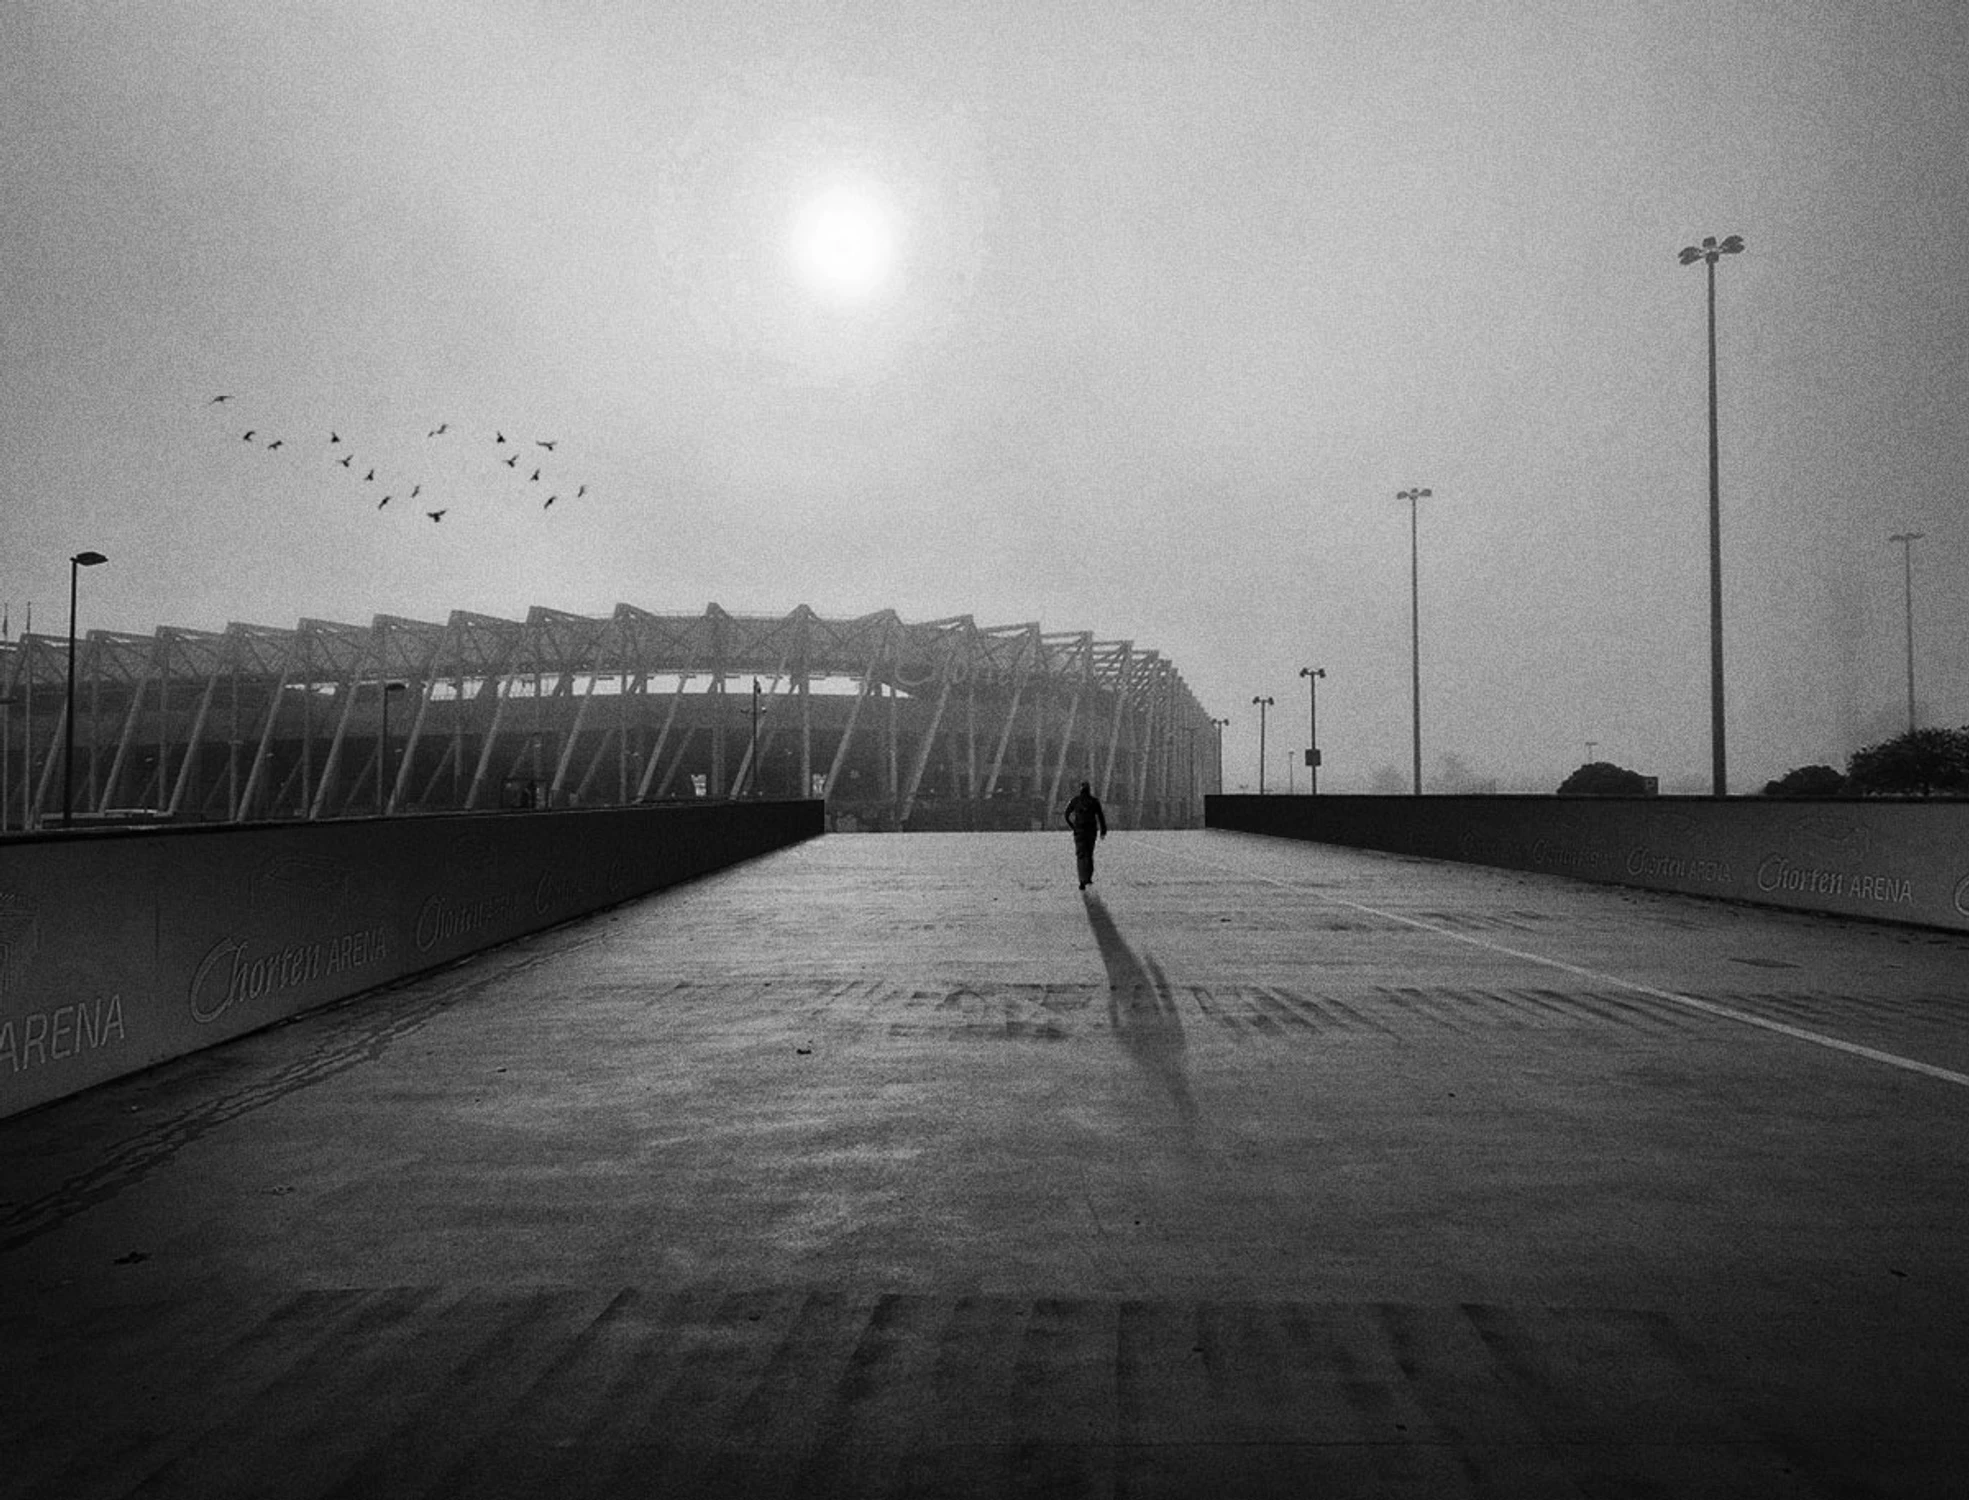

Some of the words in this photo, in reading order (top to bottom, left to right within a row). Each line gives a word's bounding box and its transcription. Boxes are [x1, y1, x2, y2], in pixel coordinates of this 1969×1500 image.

[1758, 852, 1842, 894] Chorten
[1850, 876, 1913, 902] ARENA
[190, 936, 321, 1023] Chorten
[326, 927, 388, 976] ARENA
[0, 993, 126, 1073] ARENA
